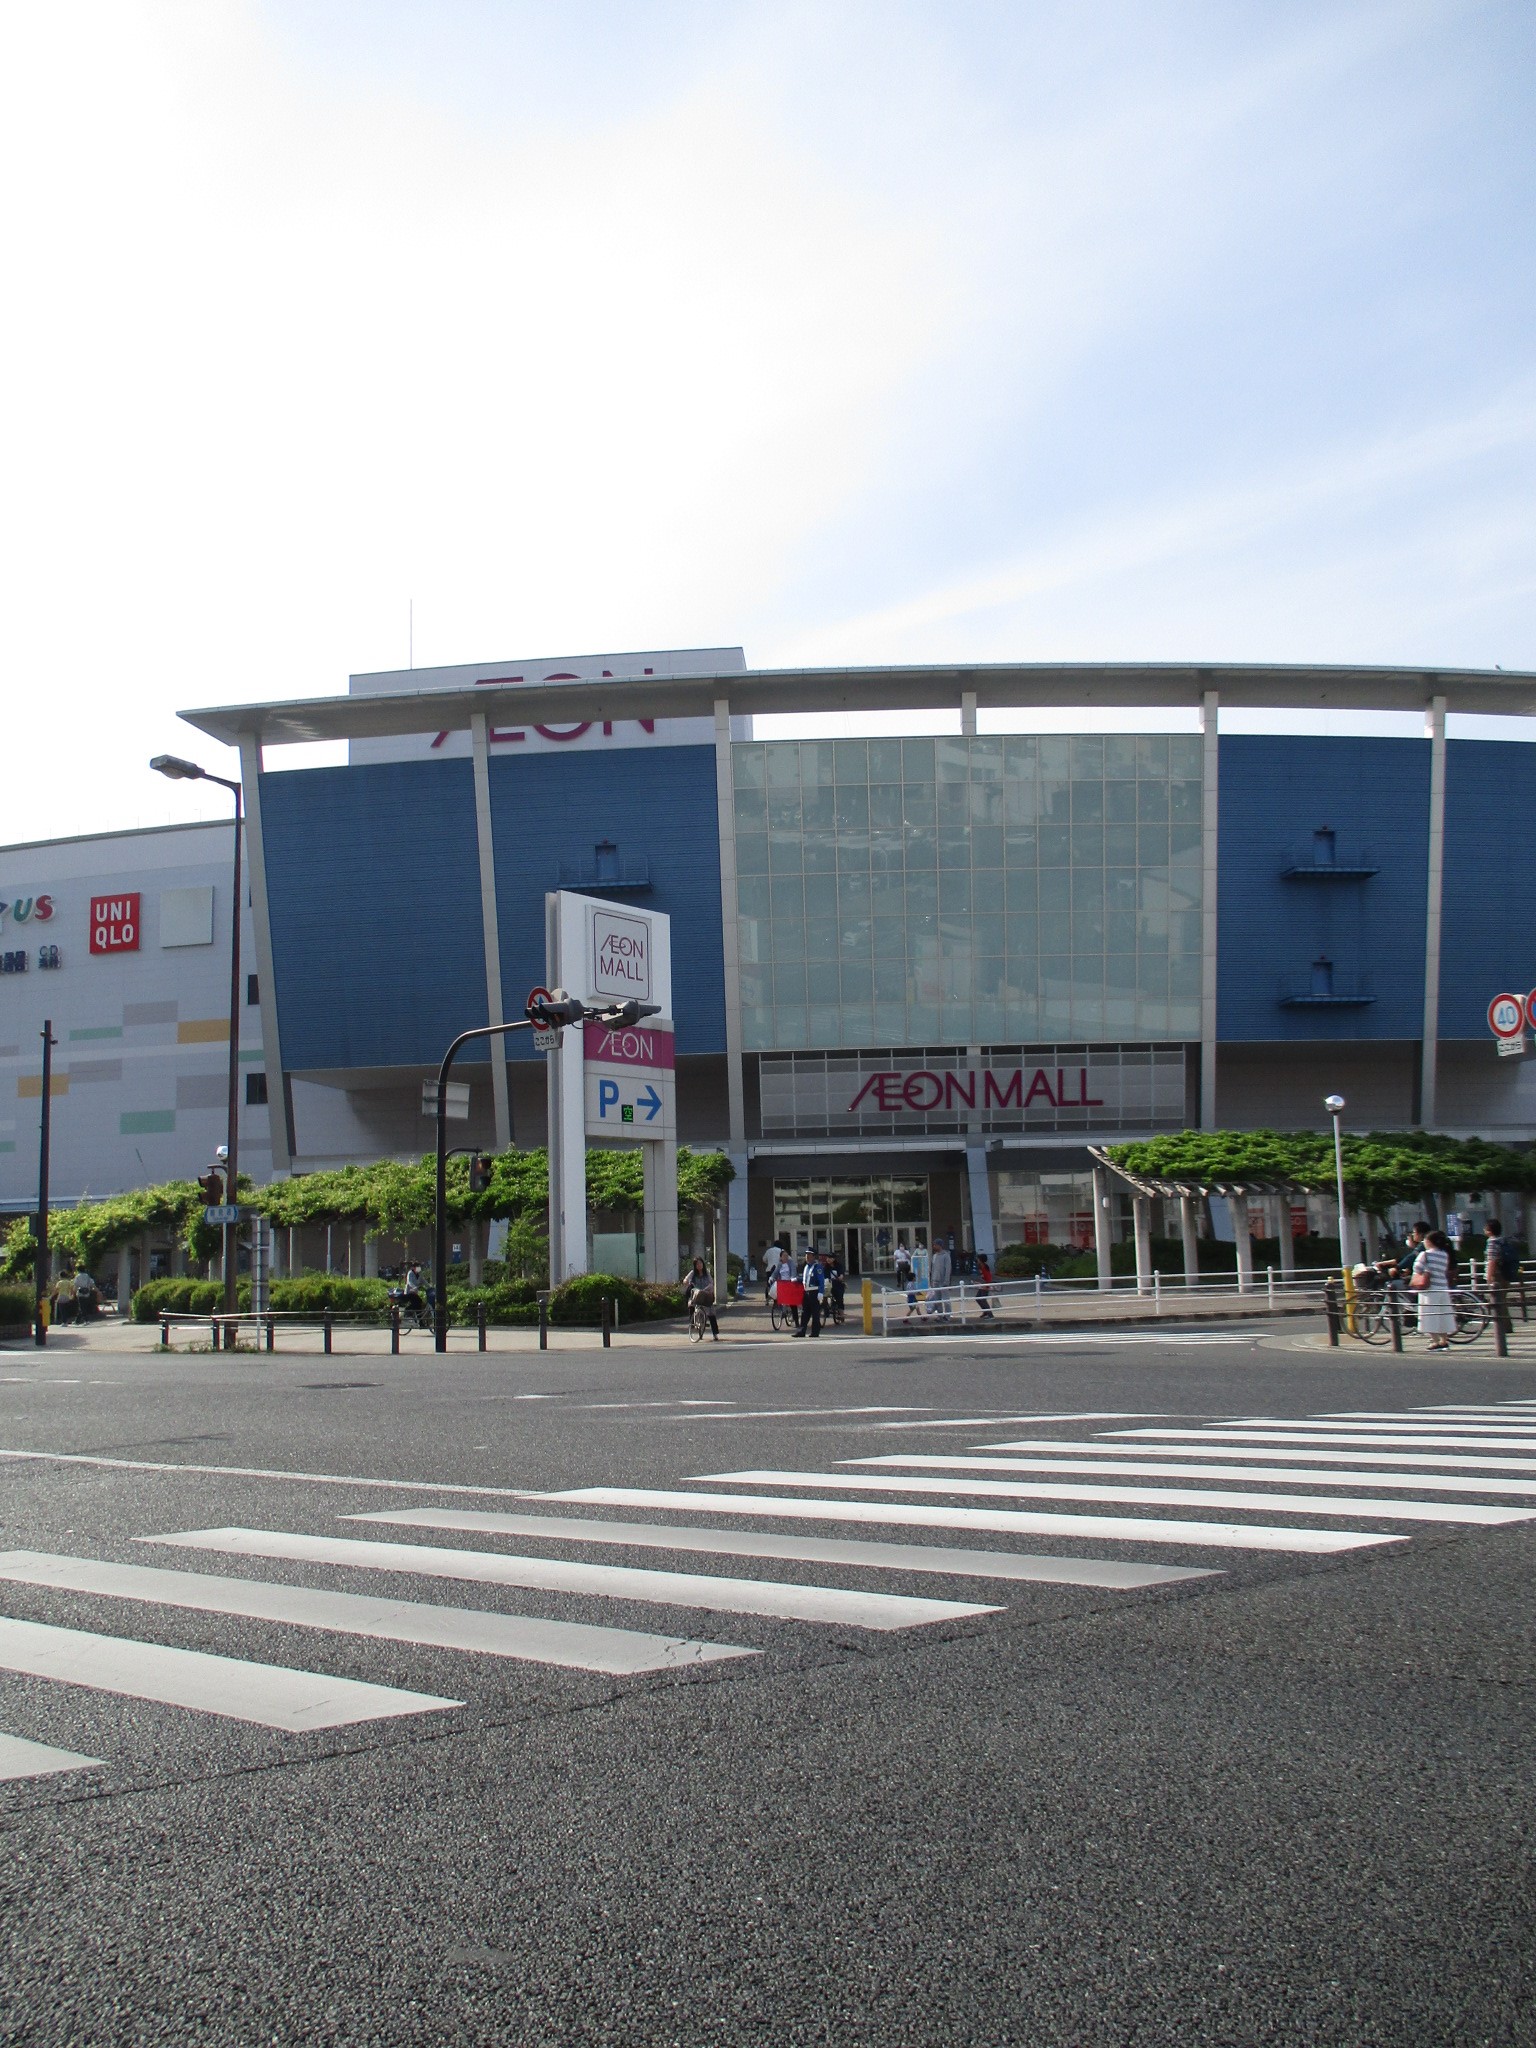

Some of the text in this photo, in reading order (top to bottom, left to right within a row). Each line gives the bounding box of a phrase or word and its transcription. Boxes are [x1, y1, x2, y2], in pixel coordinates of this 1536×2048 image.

[96, 901, 131, 922] UNI
[96, 924, 134, 949] QLO
[601, 955, 644, 981] MALL
[1498, 1006, 1517, 1024] 40
[599, 1080, 620, 1118] P
[984, 1068, 1104, 1108] MALL
